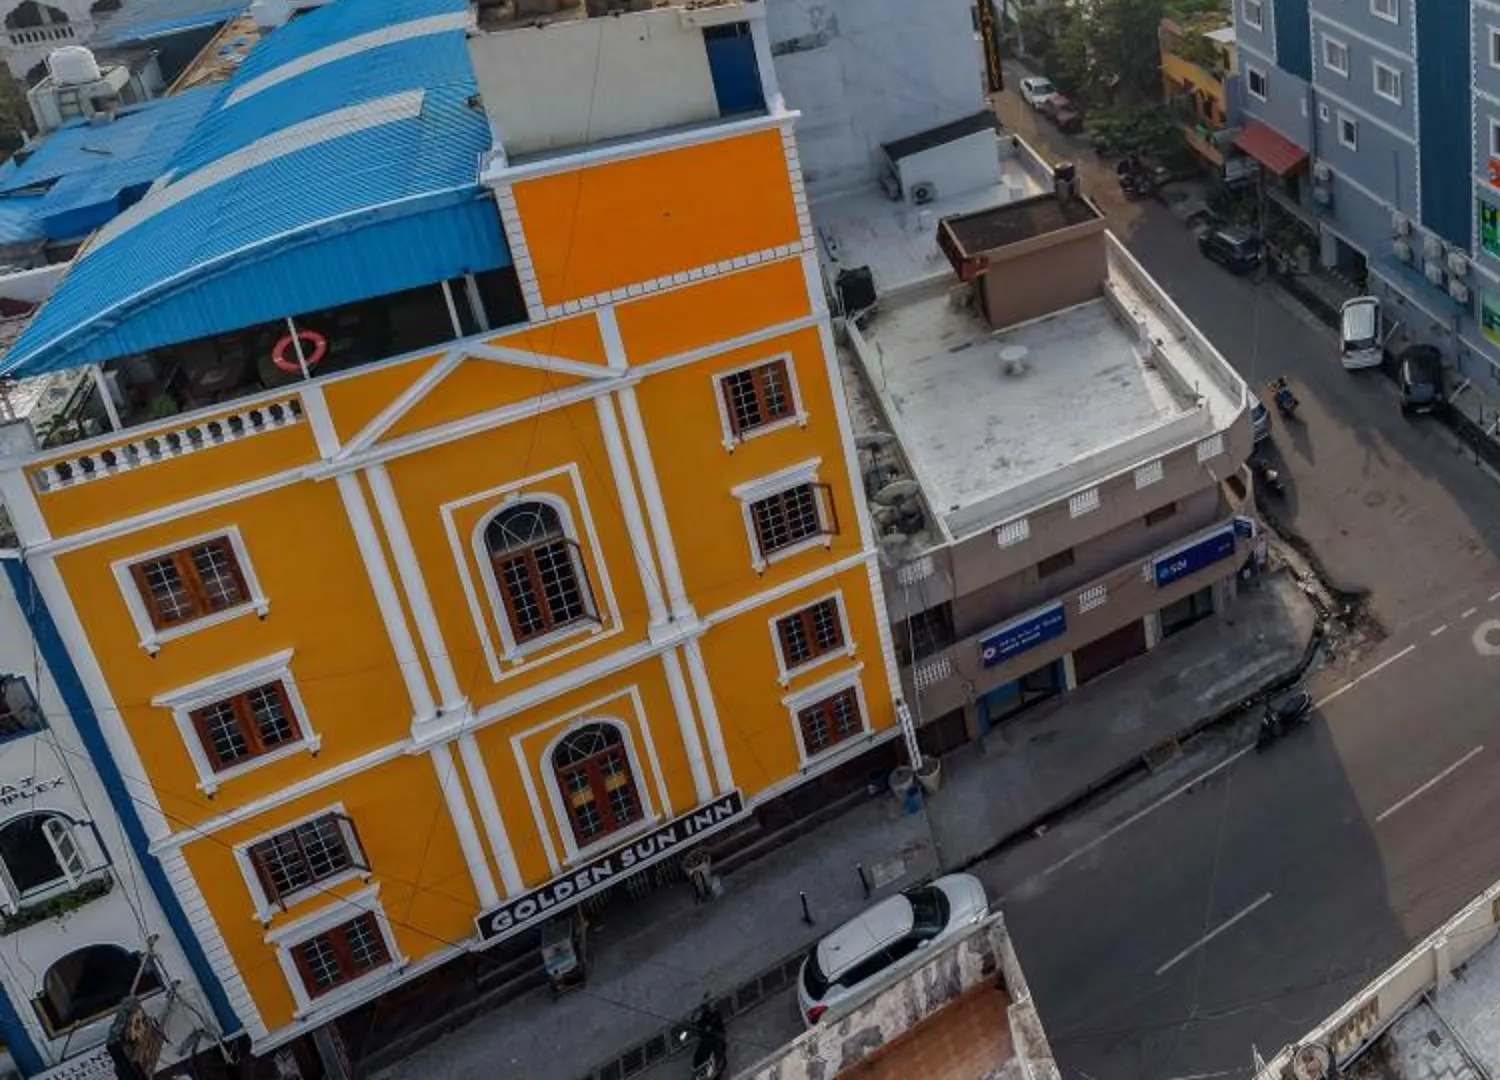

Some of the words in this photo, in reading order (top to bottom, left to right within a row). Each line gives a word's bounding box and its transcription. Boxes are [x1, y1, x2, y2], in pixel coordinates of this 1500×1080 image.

[491, 859, 615, 932] GOLDEN
[620, 828, 678, 869] SUN
[683, 799, 734, 836] INN
